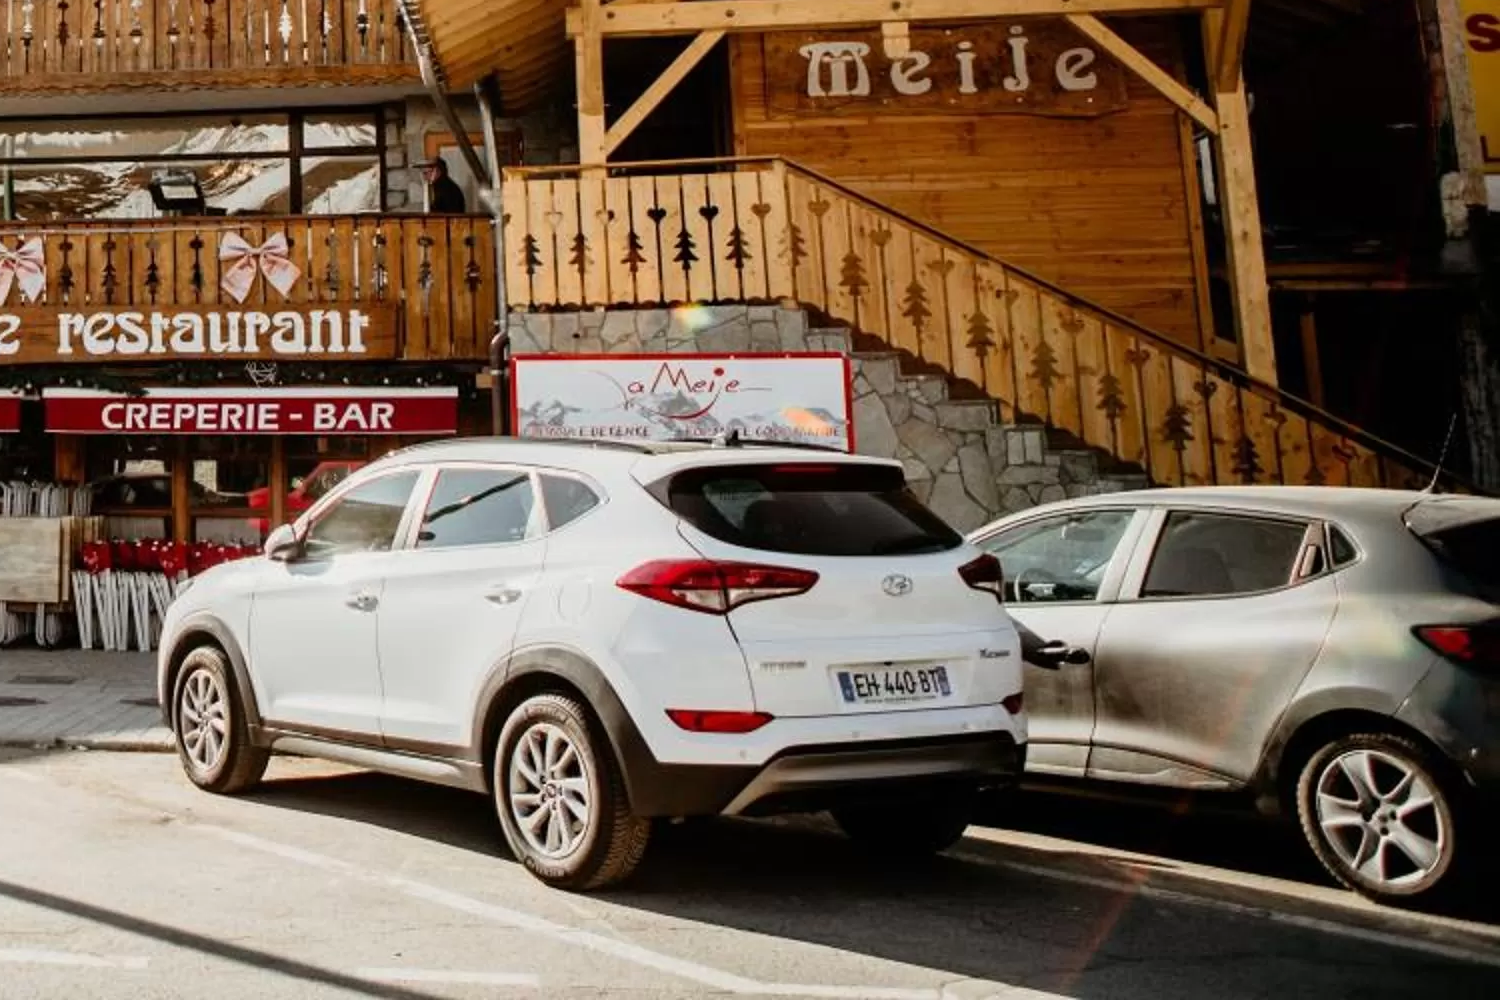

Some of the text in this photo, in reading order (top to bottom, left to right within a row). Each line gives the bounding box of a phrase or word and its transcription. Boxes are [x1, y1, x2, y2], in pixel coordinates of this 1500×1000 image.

[57, 309, 370, 356] restaurant
[101, 402, 281, 431] CREPERIE
[313, 402, 395, 431] BAR
